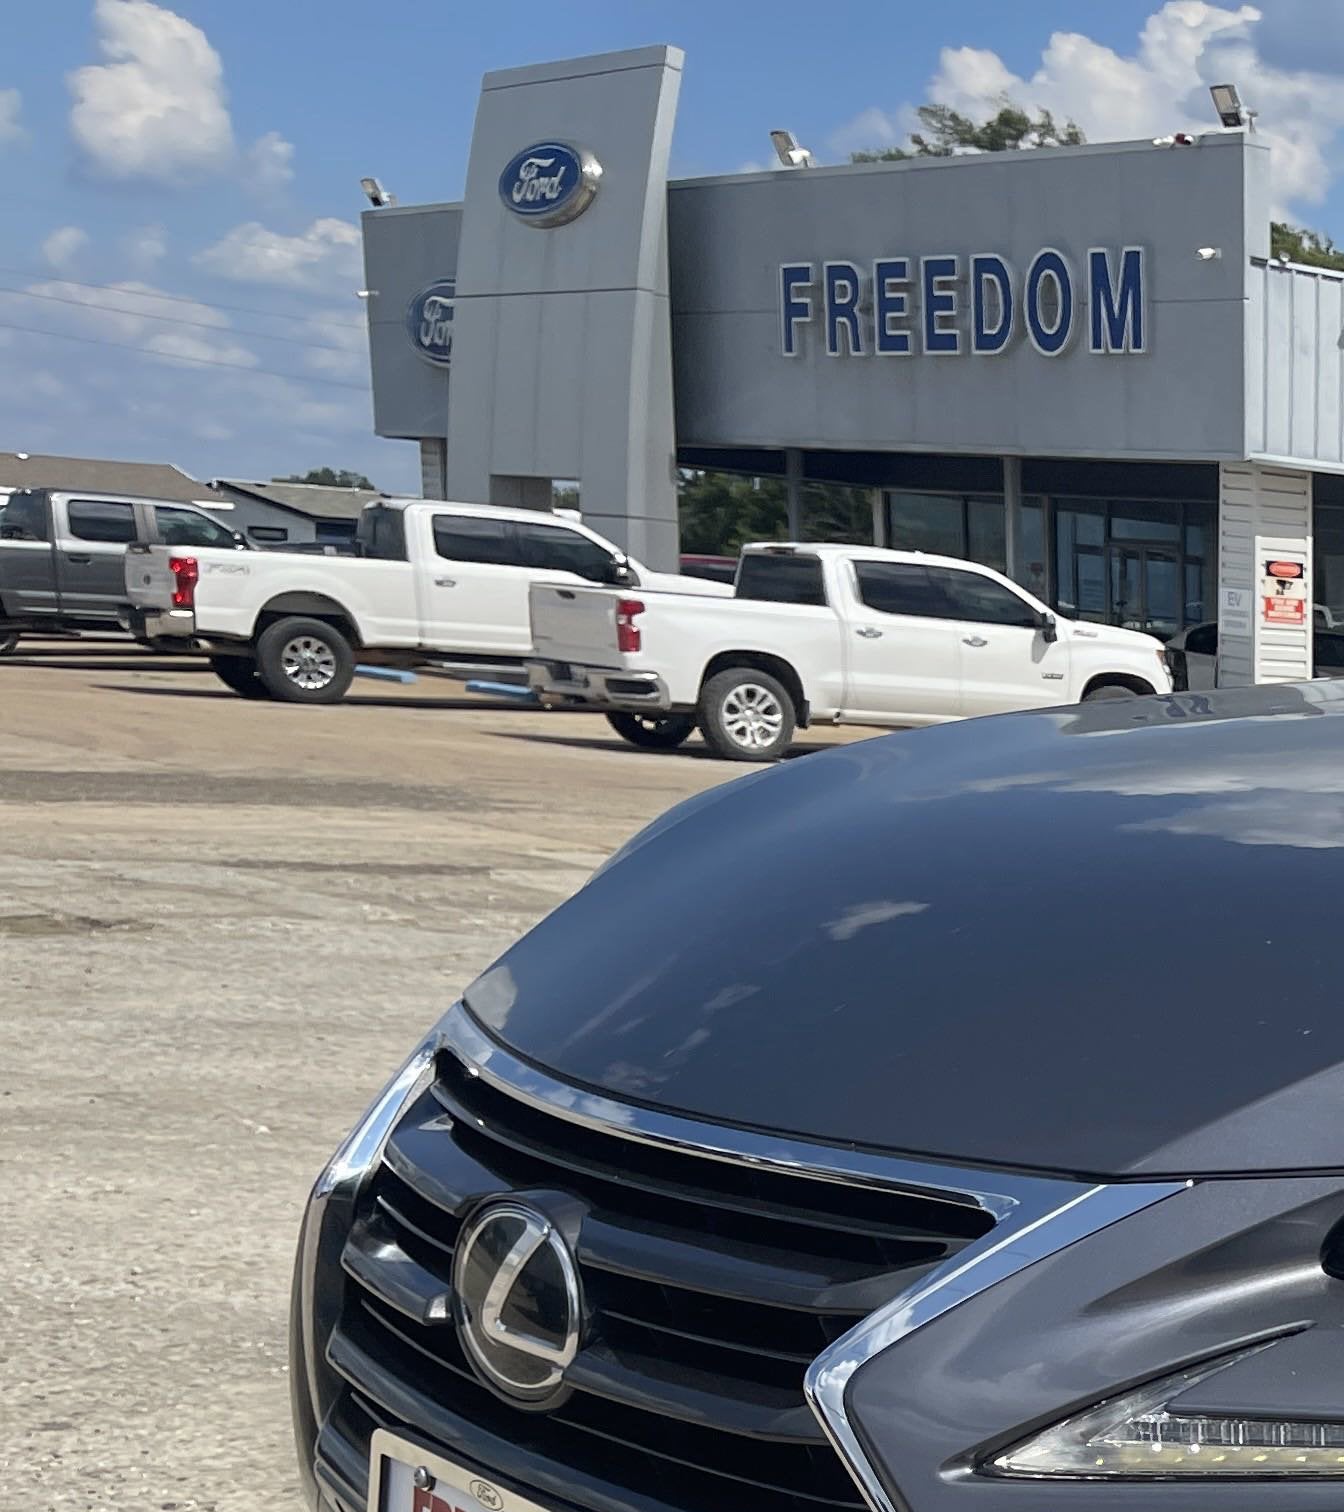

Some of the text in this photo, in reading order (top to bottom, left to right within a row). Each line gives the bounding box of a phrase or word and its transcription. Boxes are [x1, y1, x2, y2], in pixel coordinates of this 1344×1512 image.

[511, 157, 567, 204] Ford
[420, 295, 455, 347] For
[778, 245, 1146, 357] FREEDOM
